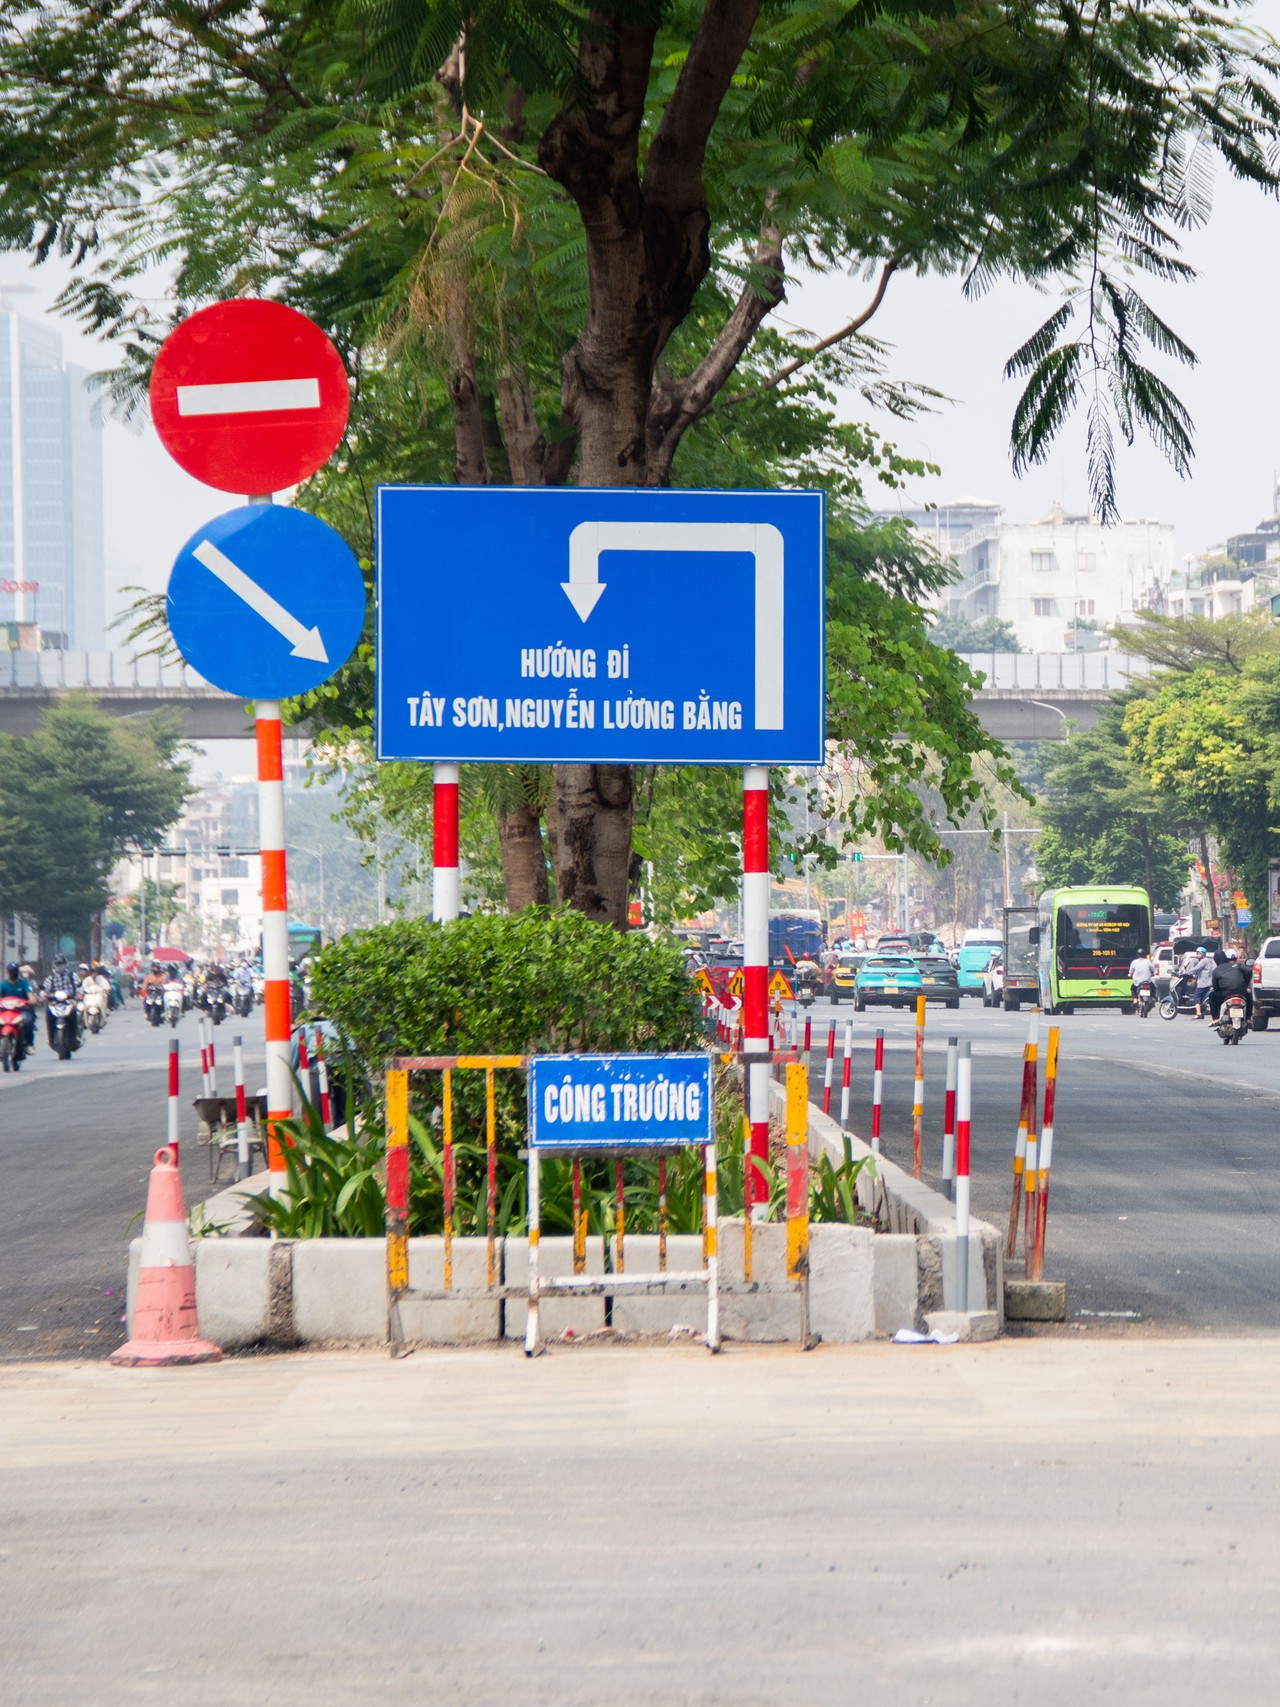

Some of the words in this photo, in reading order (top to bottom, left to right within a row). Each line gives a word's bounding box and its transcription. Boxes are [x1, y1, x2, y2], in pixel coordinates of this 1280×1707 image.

[520, 640, 597, 679] HƯỚNG
[407, 691, 445, 727] TÂY
[682, 688, 742, 731] BẰNG
[544, 1074, 606, 1123] CÔNG
[610, 1072, 700, 1122] TRƯỜNG
